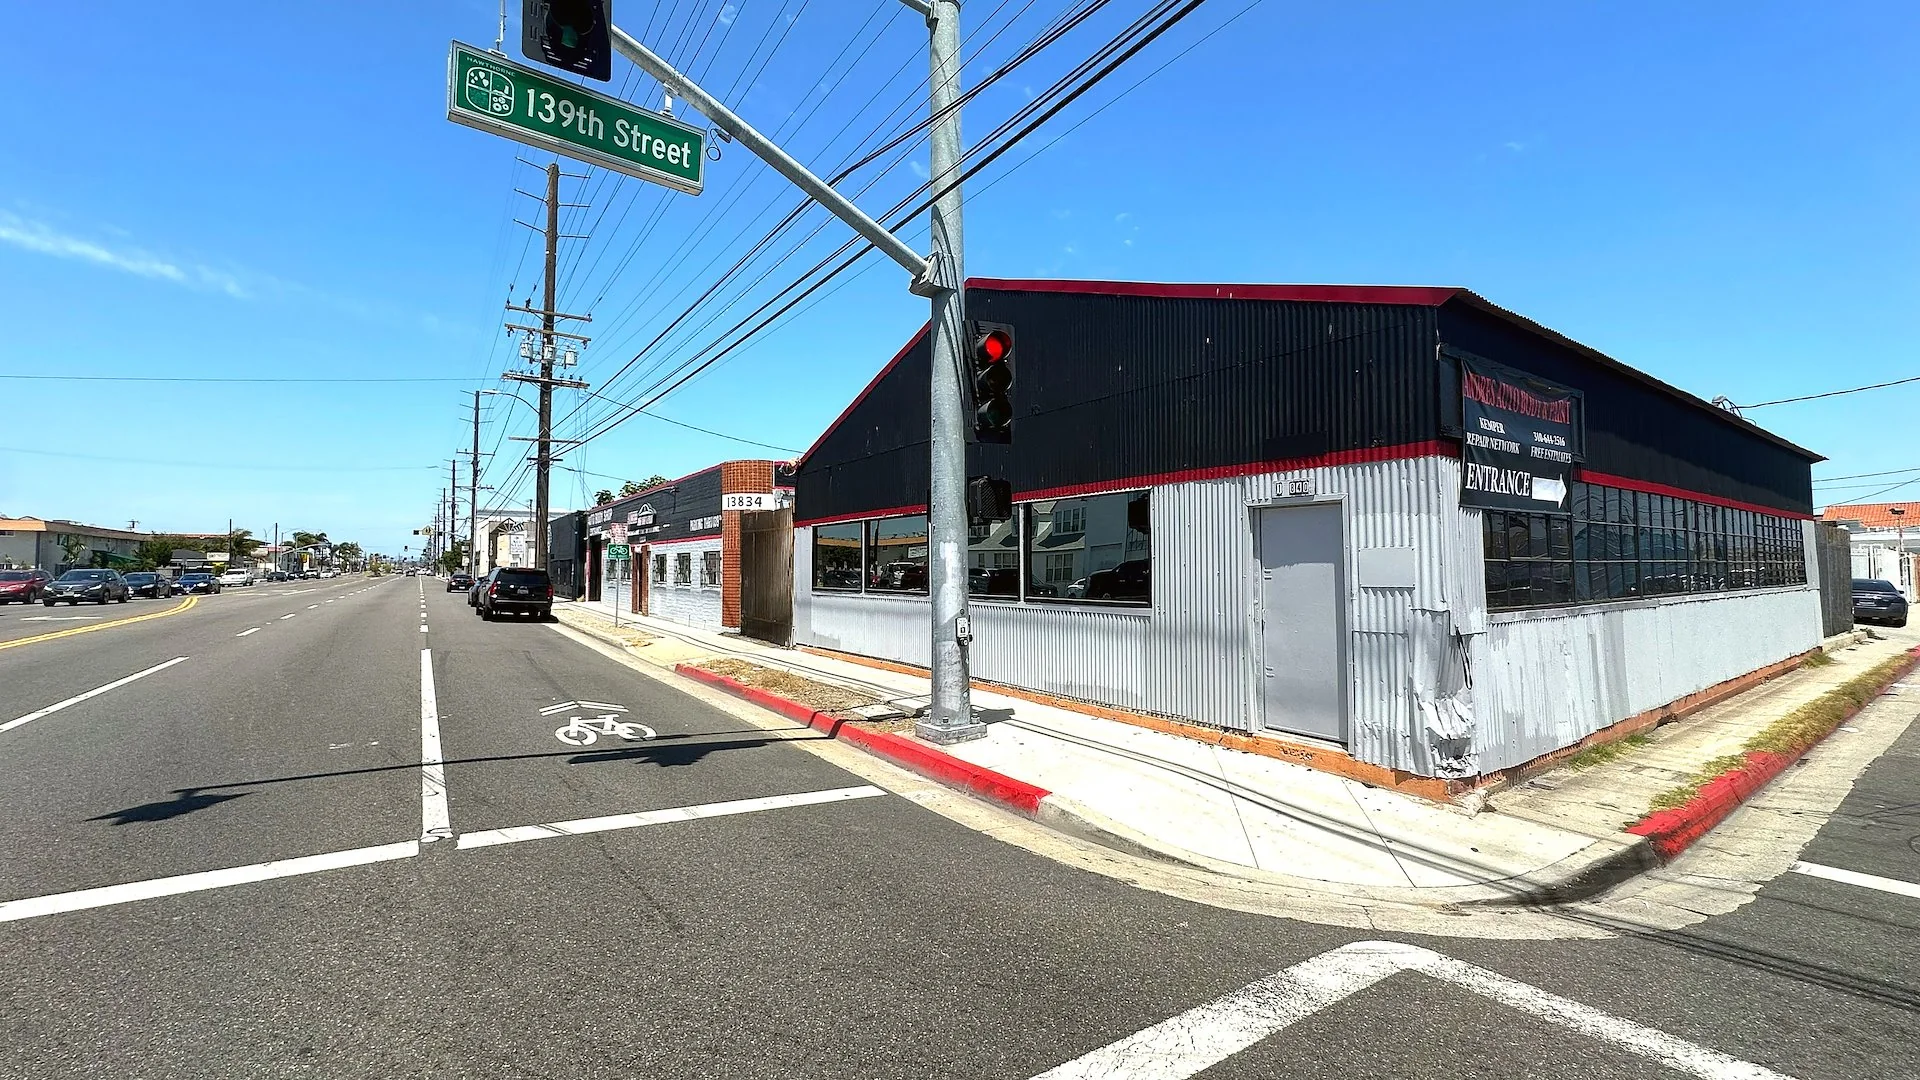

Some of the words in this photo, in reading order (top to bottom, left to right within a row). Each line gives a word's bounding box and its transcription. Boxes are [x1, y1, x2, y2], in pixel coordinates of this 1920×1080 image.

[466, 57, 516, 77] HAWTHORNE
[527, 88, 604, 140] 139th
[613, 118, 691, 168] Street
[1496, 381, 1520, 413] AUTO
[1549, 400, 1571, 424] PAINT
[1479, 417, 1505, 434] KEMPER
[1466, 432, 1489, 449] REPAIR
[1489, 437, 1520, 454] NETWORK
[1531, 446, 1544, 459] FREE
[1465, 463, 1530, 496] ENTRANCE
[727, 496, 762, 507] 13834
